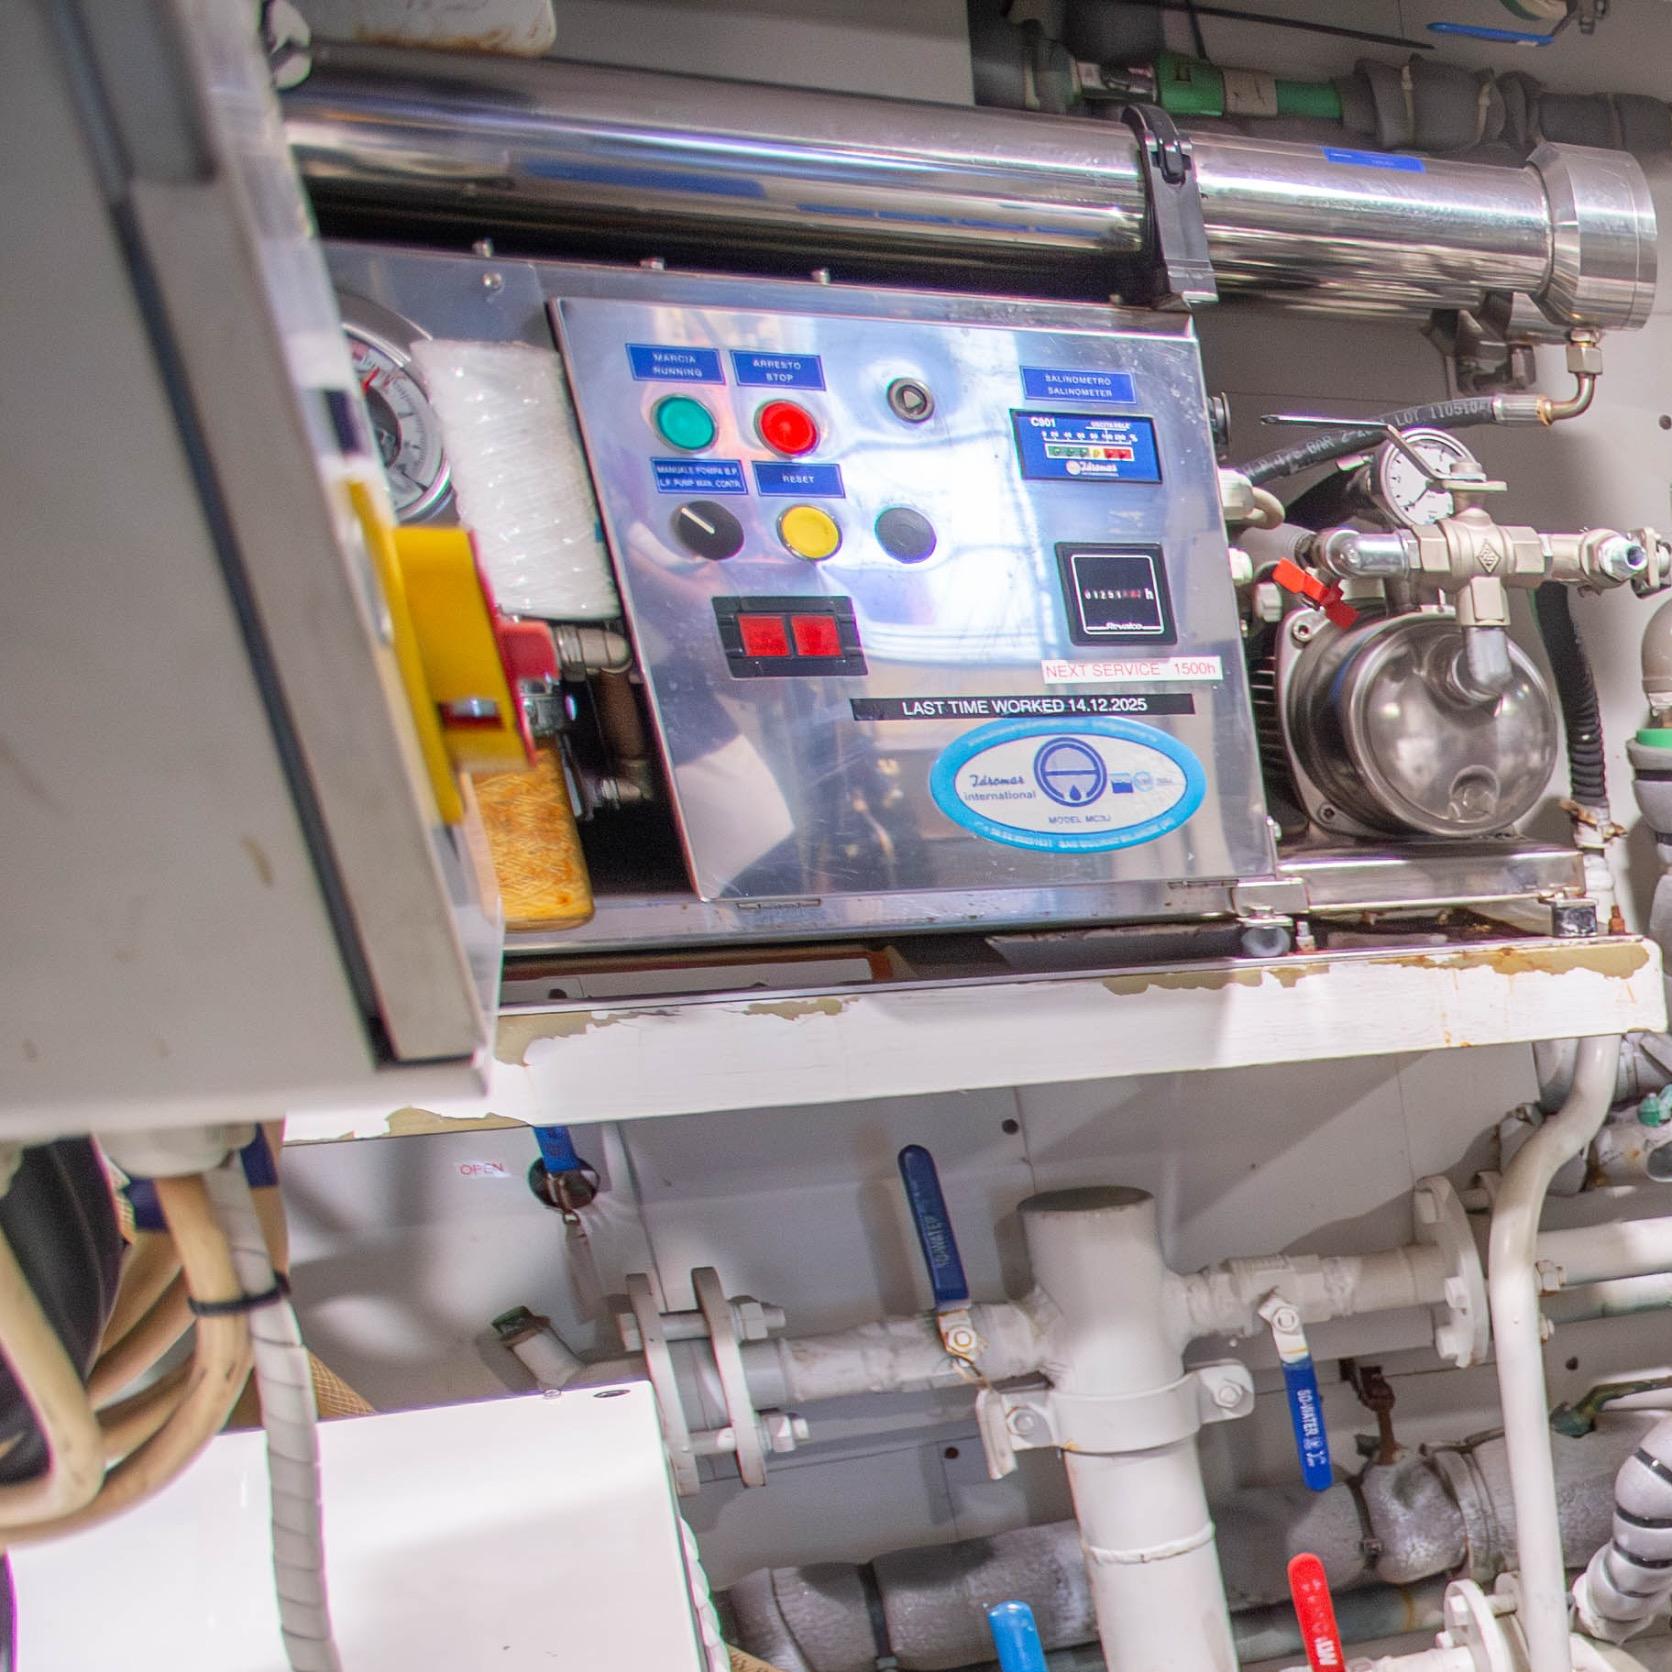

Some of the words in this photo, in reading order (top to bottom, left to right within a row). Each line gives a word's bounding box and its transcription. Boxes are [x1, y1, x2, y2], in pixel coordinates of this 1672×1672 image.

[653, 353, 696, 364] MARCIA
[752, 359, 801, 371] ARRESTO
[653, 367, 703, 378] RUNNING
[766, 373, 794, 383] STOP
[1045, 374, 1112, 386] SALINOMETRO
[1047, 387, 1113, 398] SALINOMETER
[1030, 416, 1056, 428] C901
[782, 474, 815, 484] RESET
[1045, 664, 1088, 679] NEXT
[1092, 663, 1161, 677] SERVICE
[1174, 662, 1216, 676] 1500h
[902, 701, 945, 716] LAST
[948, 700, 989, 715] TIME
[992, 699, 1065, 714] WORKED
[1068, 698, 1148, 713] 14.12.2025
[964, 789, 1037, 802] international
[1048, 815, 1081, 825] MODEL
[460, 1162, 504, 1176] OPEN
